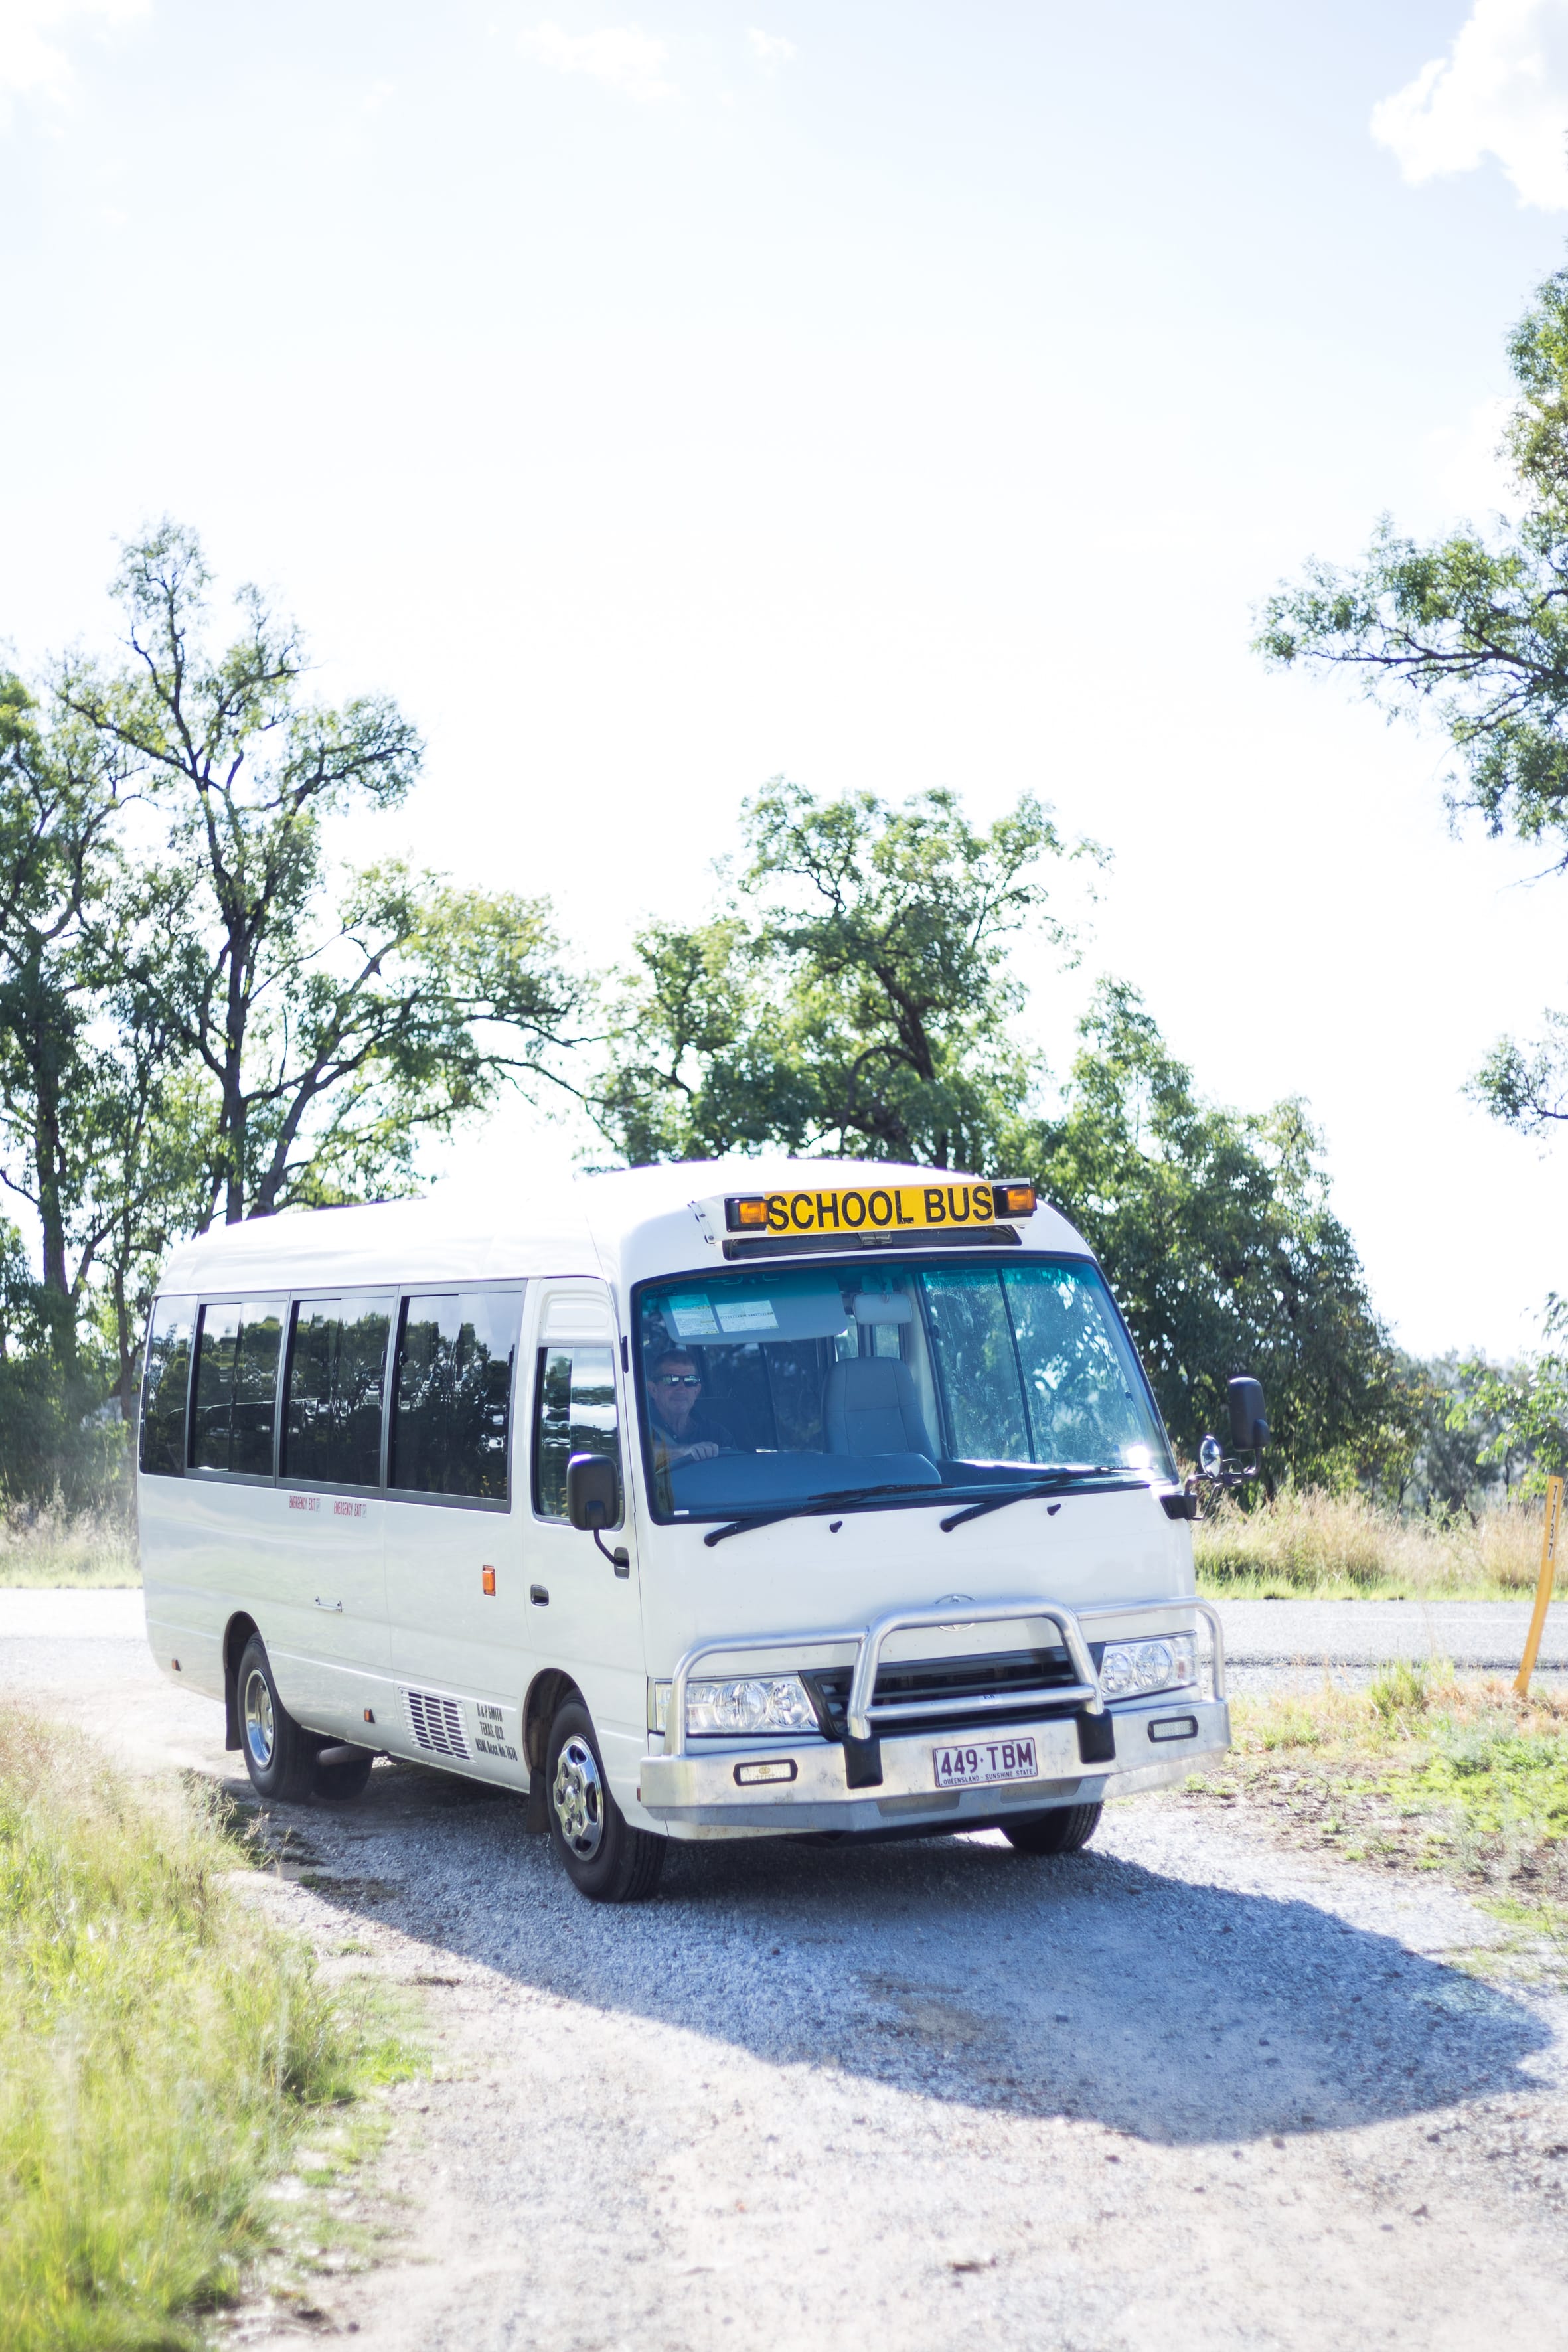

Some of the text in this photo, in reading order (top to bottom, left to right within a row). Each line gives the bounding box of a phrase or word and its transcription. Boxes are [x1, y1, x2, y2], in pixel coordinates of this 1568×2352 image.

[768, 1186, 994, 1231] SCHOOL BUS
[289, 1495, 307, 1510] EMERGENCY
[334, 1501, 353, 1516] EMERGENCY
[488, 1705, 503, 1722] SMITH
[943, 1776, 980, 1785] QUEENSLAND
[985, 1771, 1013, 1780] SUNSHINE
